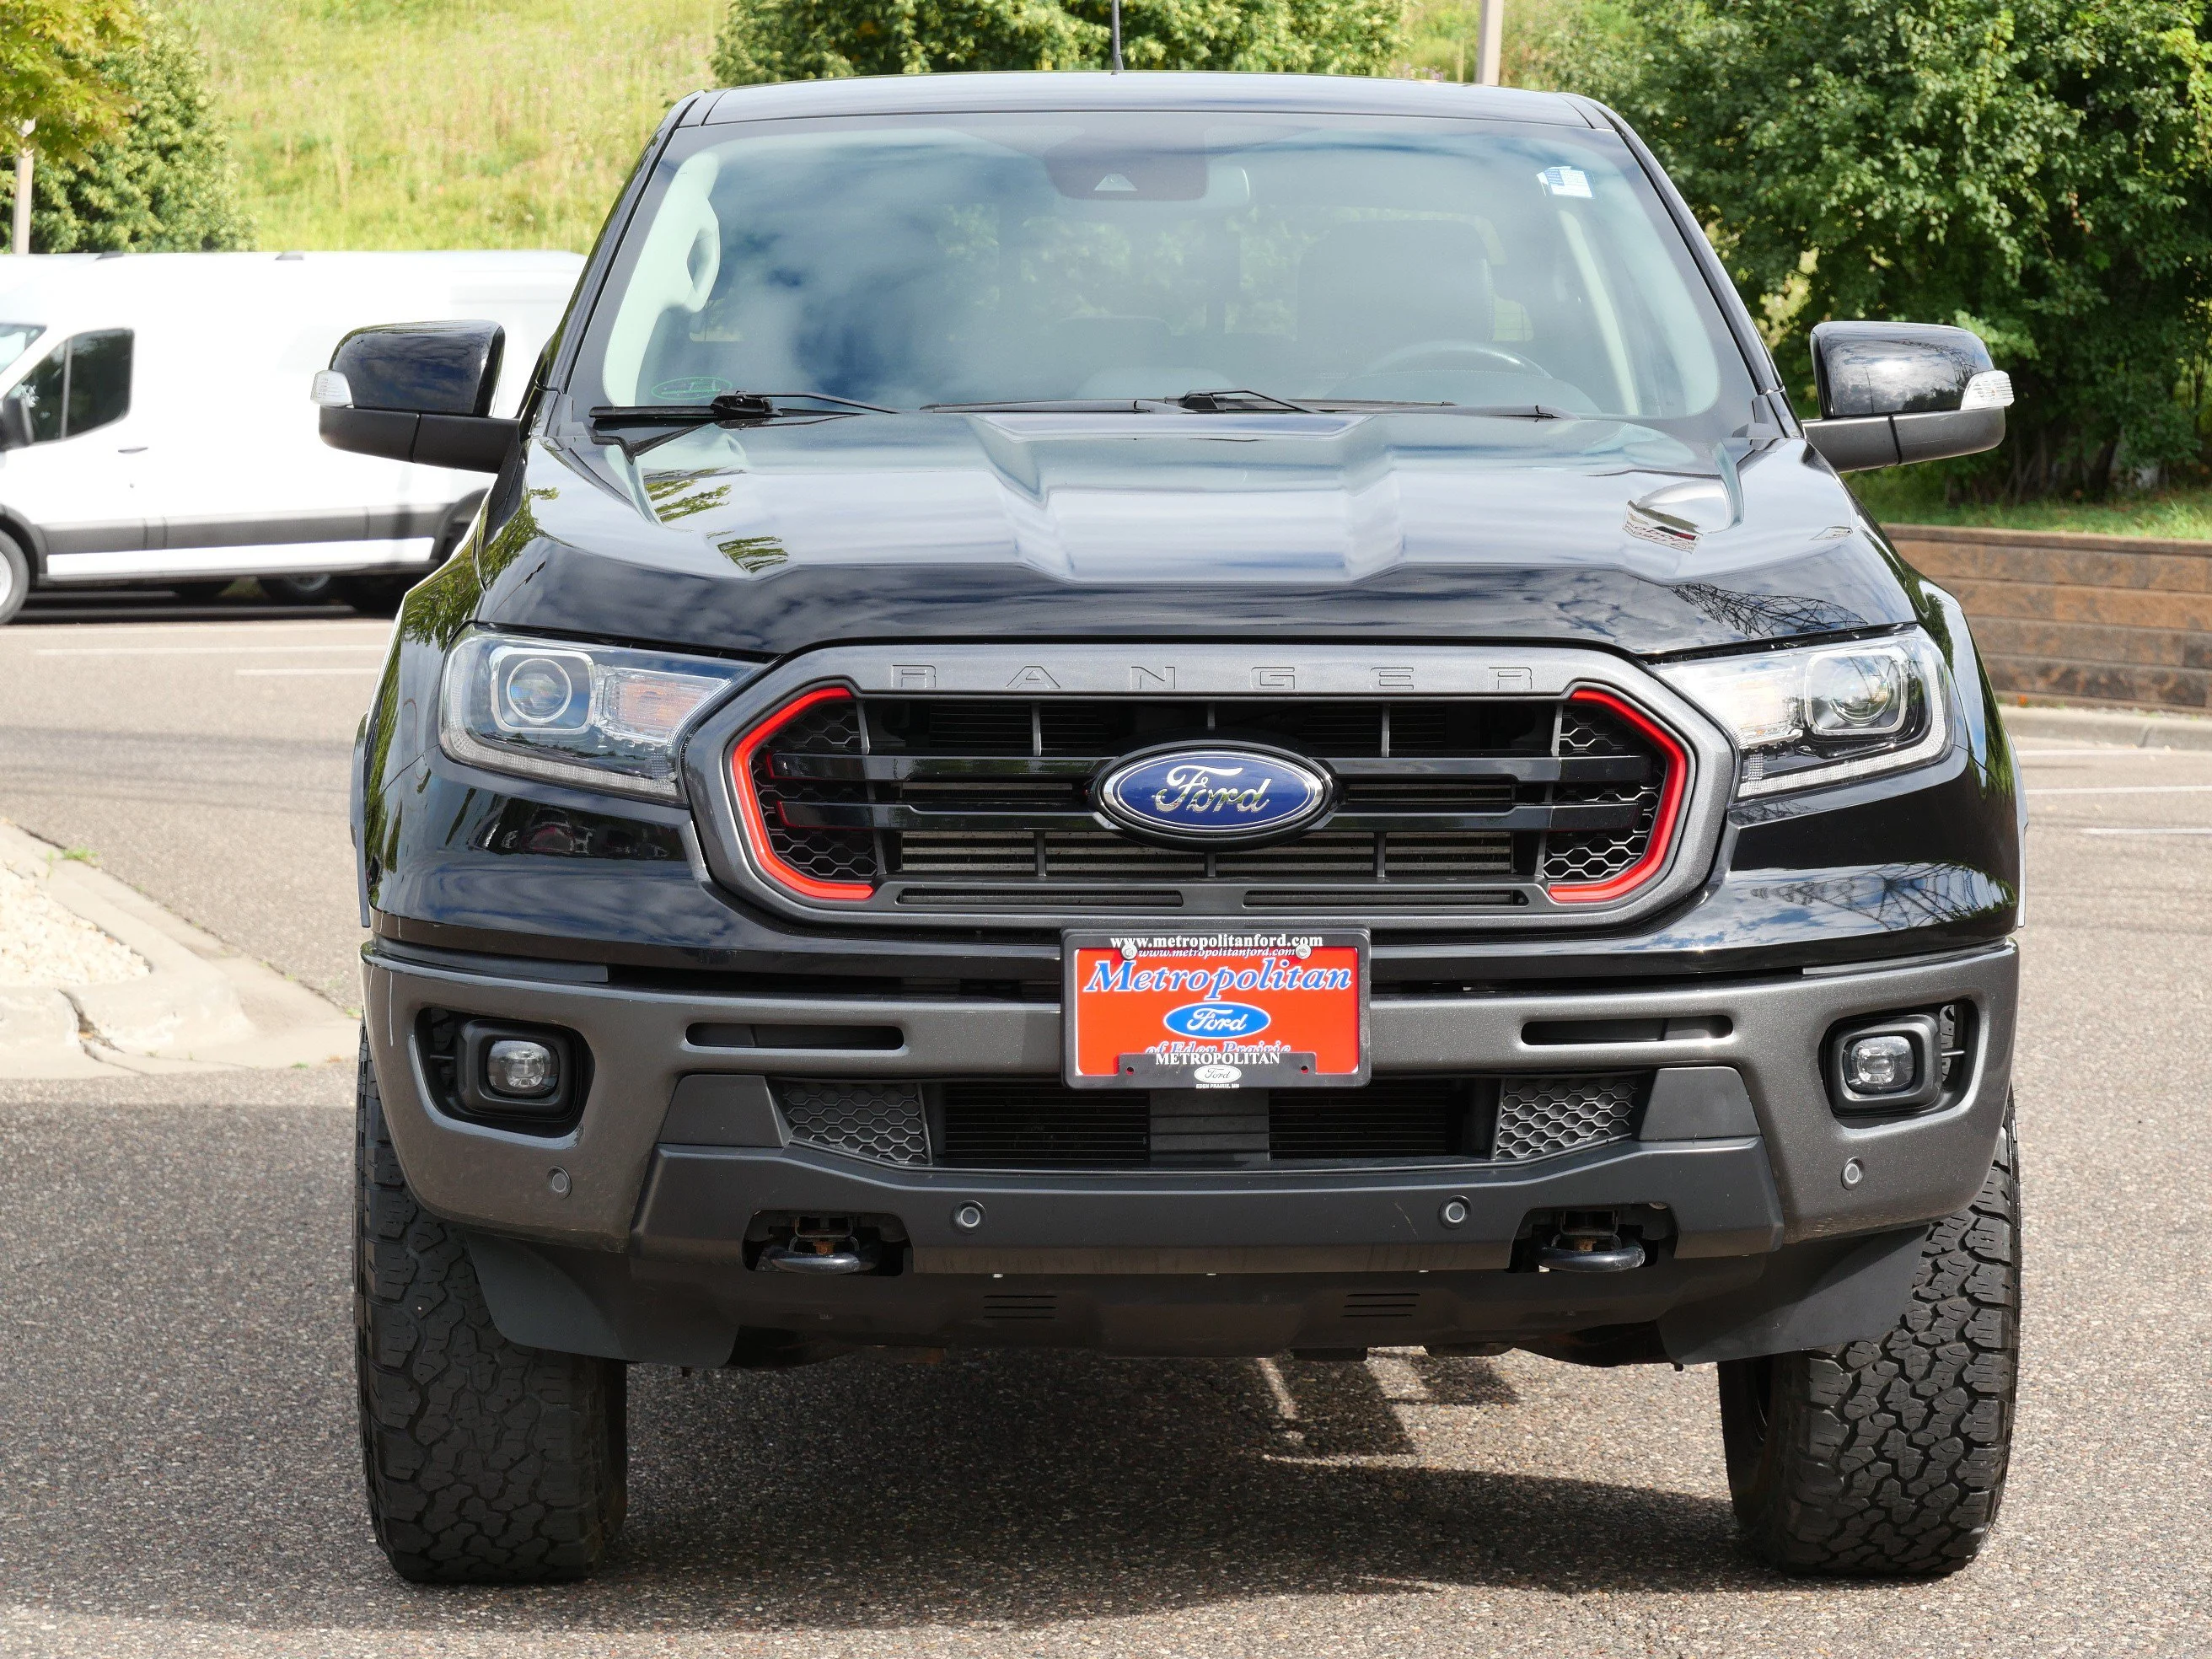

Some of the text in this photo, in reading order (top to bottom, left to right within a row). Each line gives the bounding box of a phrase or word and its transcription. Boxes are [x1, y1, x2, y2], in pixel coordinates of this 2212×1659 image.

[890, 664, 1532, 690] RANGER
[1152, 765, 1272, 812] Ford
[1110, 934, 1323, 953] www.metropolitanford.com
[1138, 946, 1296, 959] www.metropolitanford.com
[1083, 958, 1352, 1001] Metropolitan
[1186, 1007, 1248, 1031] Ford
[1155, 1052, 1280, 1065] METROPOLITAN
[1204, 1067, 1231, 1079] Ford
